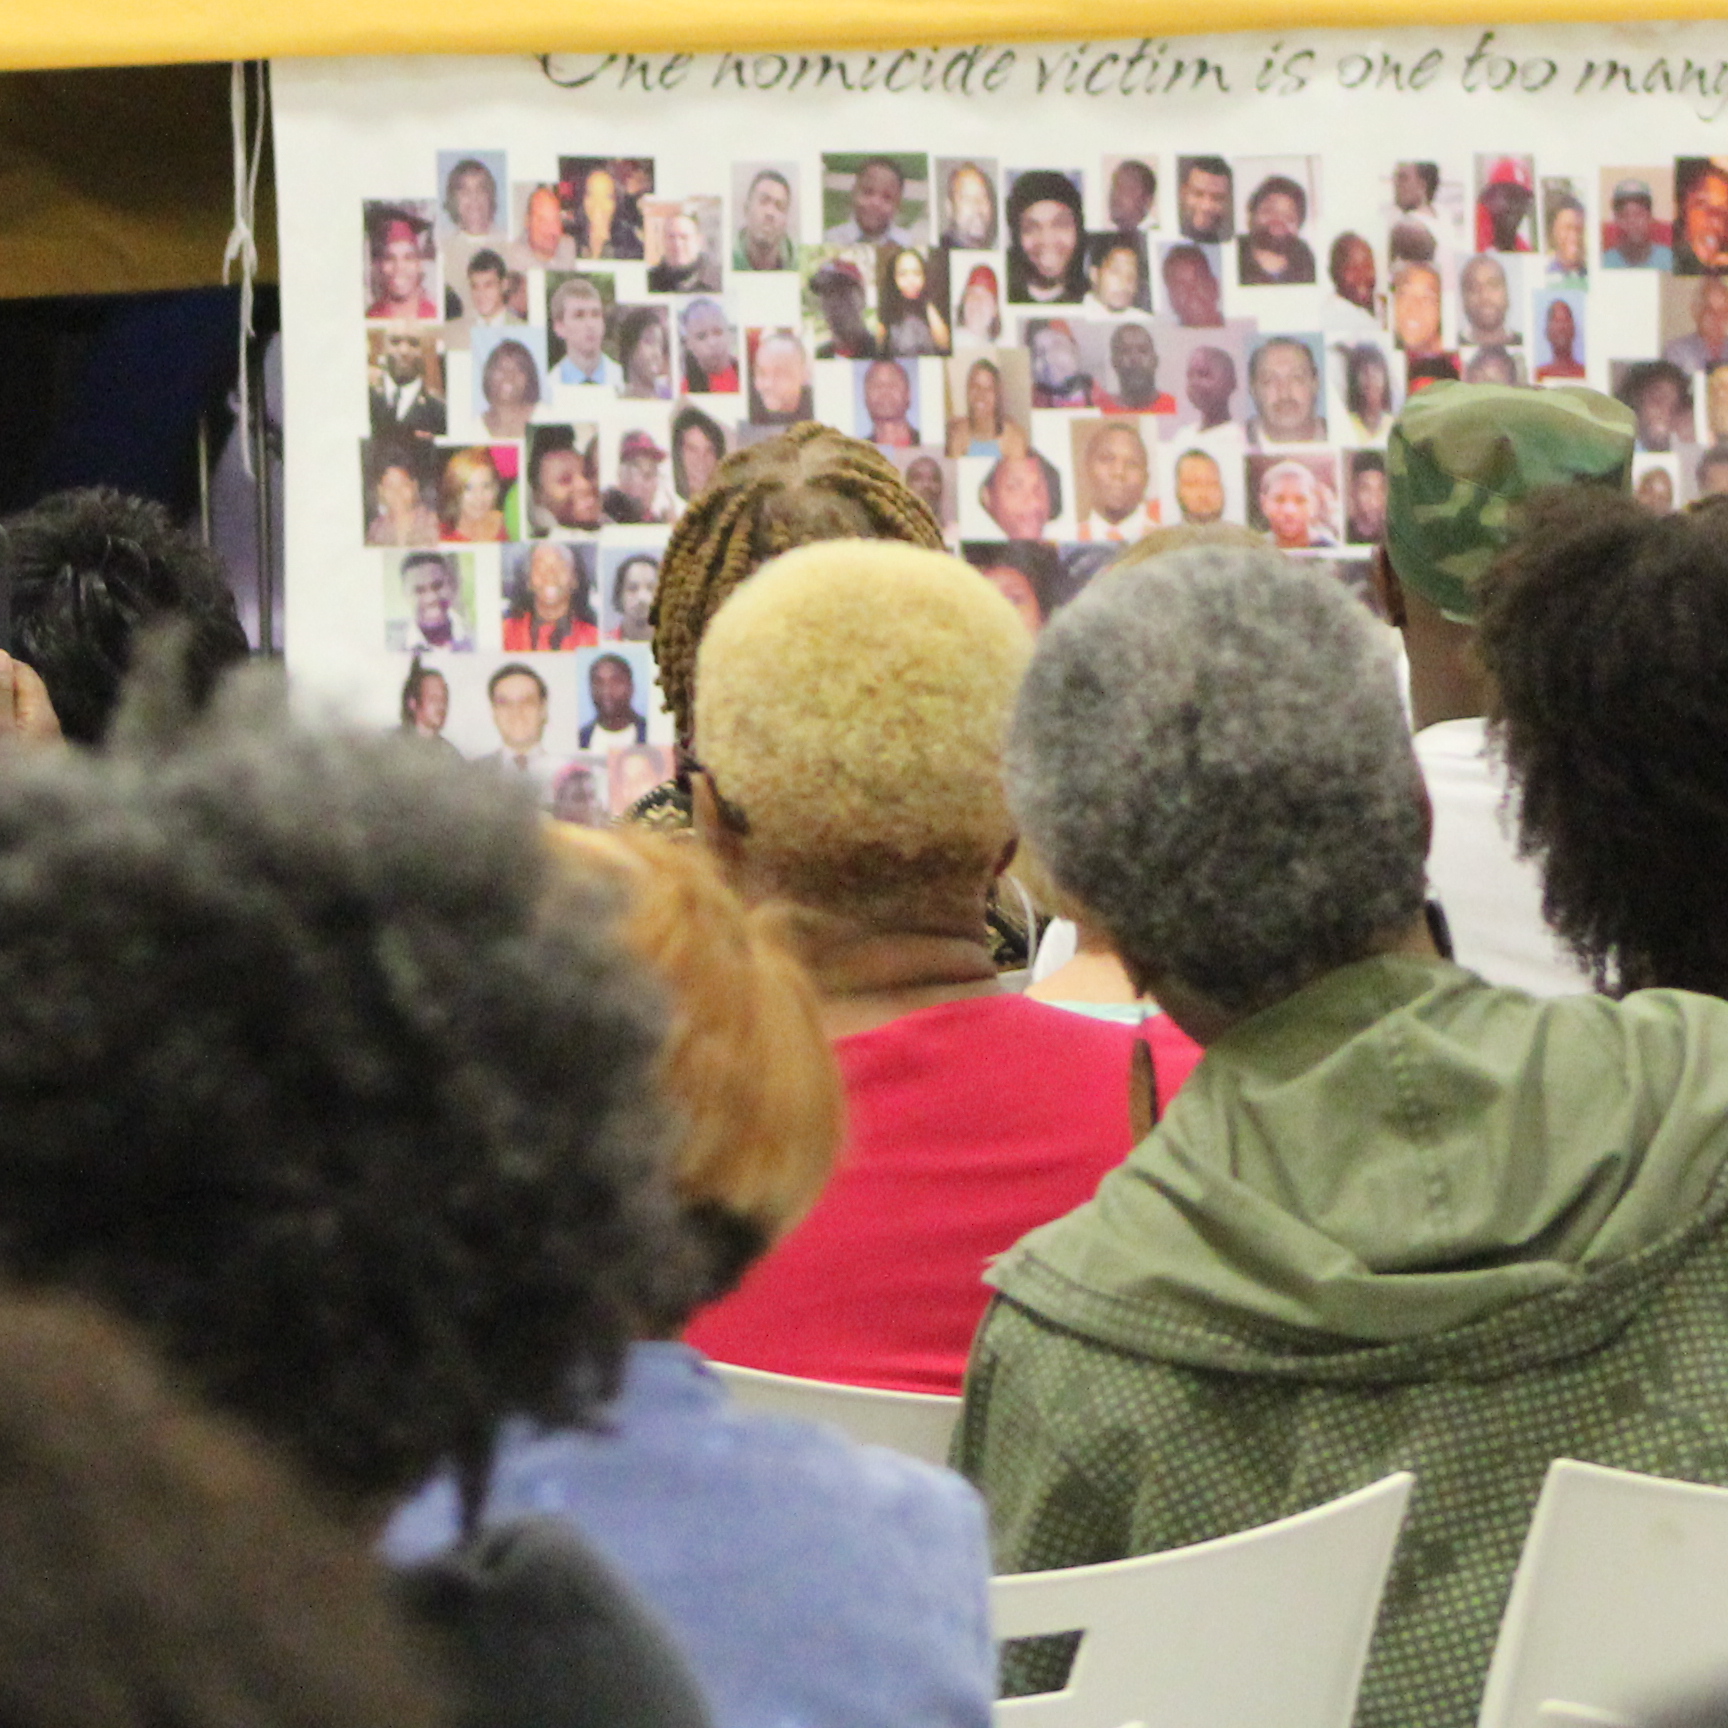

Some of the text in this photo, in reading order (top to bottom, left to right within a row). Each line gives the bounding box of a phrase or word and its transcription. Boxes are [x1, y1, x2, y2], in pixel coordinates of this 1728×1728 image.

[1032, 36, 1231, 97] victim
[1254, 41, 1316, 96] is
[1336, 47, 1445, 92] one
[1460, 29, 1560, 95] too
